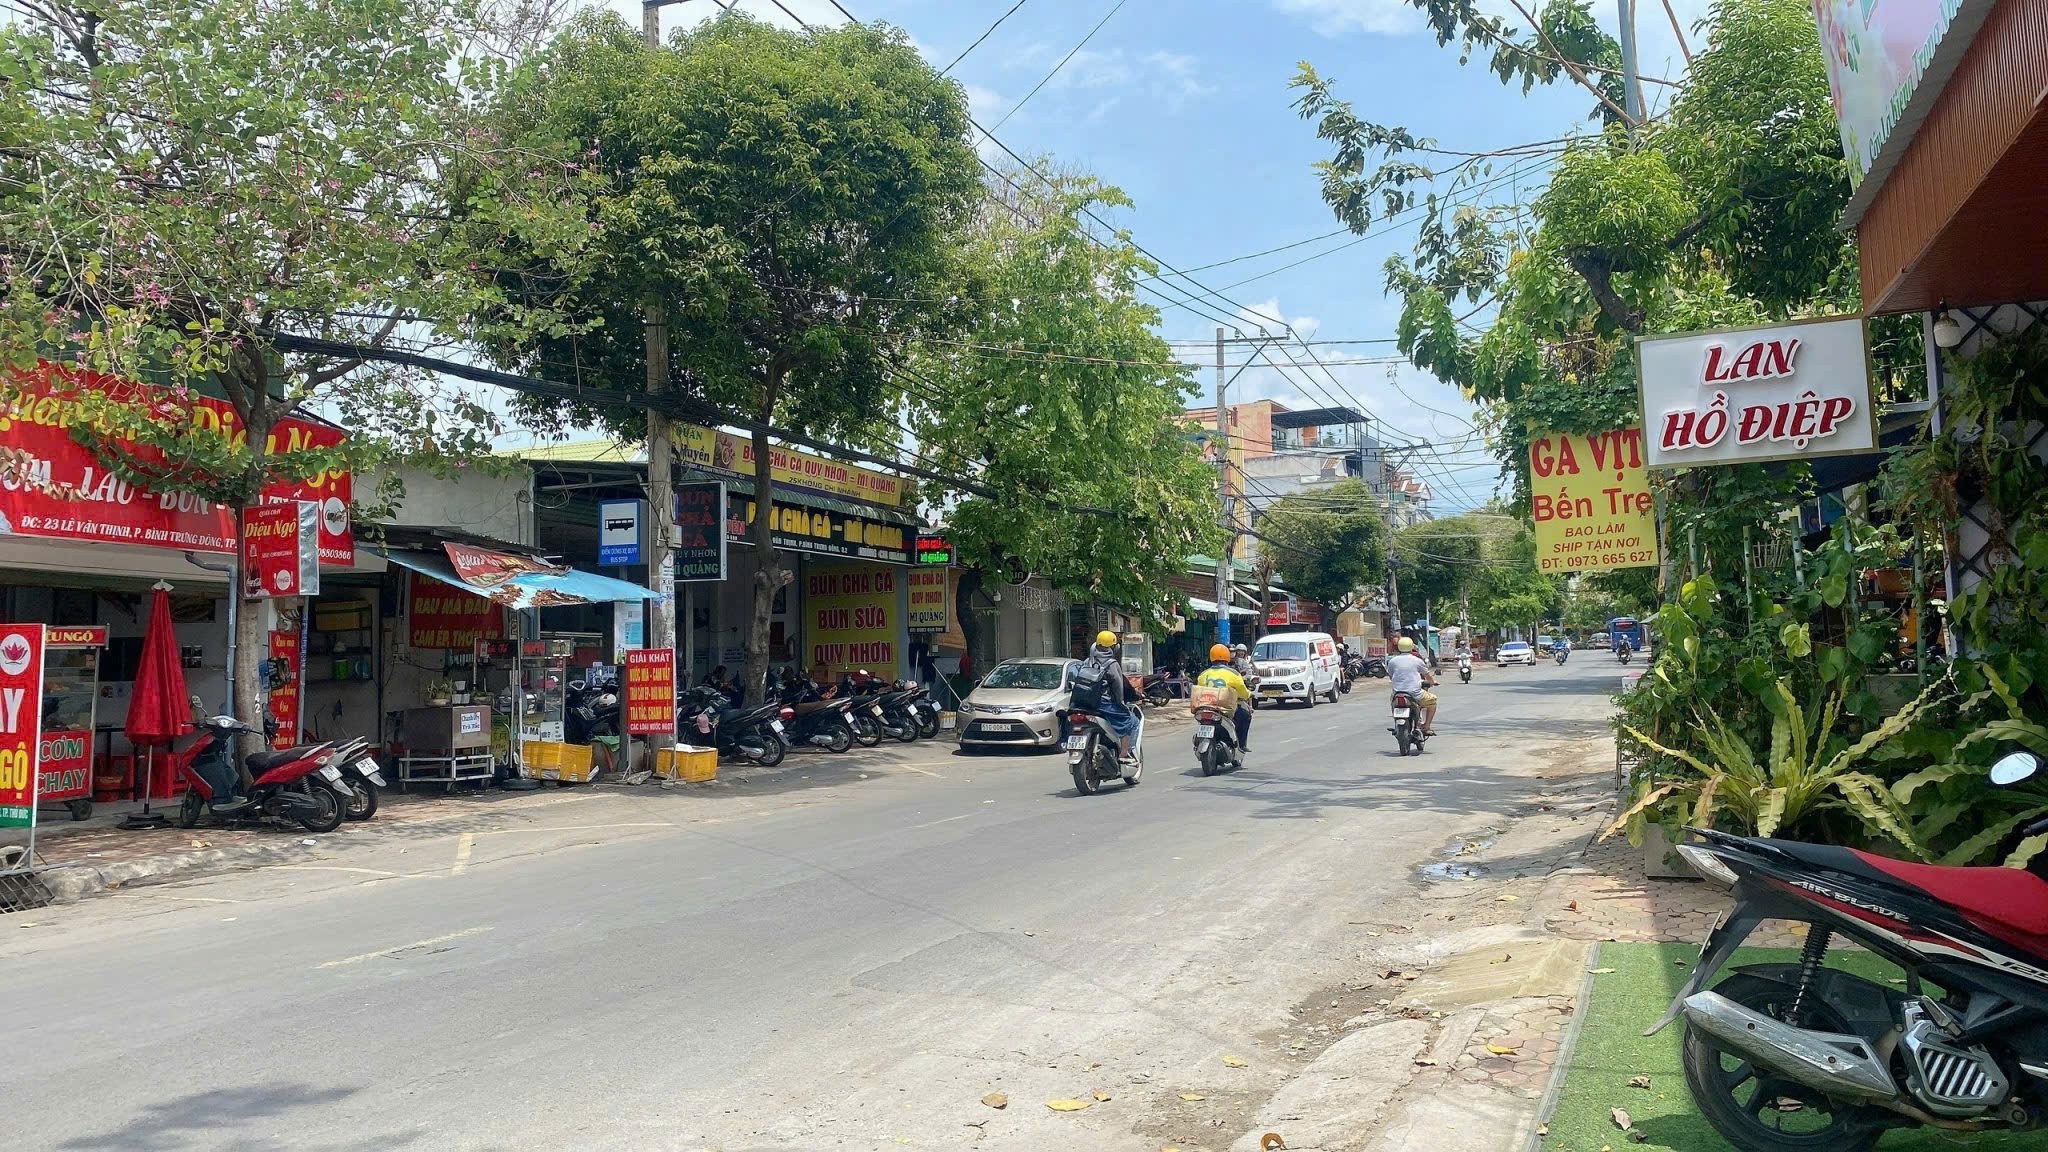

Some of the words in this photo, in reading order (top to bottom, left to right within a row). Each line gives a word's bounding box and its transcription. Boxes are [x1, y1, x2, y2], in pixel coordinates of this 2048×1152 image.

[1705, 339, 1798, 382] LAN
[1662, 393, 1726, 447] HỒ
[1738, 390, 1852, 446] ĐIỆP
[804, 460, 823, 476] QUY
[824, 464, 848, 483] NHƠN
[1533, 486, 1593, 522] Bến
[21, 515, 41, 529] ĐC:
[43, 517, 59, 530] 23
[61, 518, 74, 532] LÊ
[76, 520, 97, 534] VĂN
[145, 527, 168, 540] BÌNH
[245, 522, 271, 541] Diệu
[273, 518, 297, 538] Ngộ
[1565, 525, 1594, 538] BAO
[1553, 542, 1583, 554] SHIP
[1616, 536, 1641, 548] NƠI
[683, 560, 719, 577] QUẢNG
[1542, 558, 1563, 569] ĐT:
[1567, 555, 1599, 567] 0973
[1602, 552, 1626, 565] 665
[1629, 550, 1653, 562] 627
[630, 652, 647, 664] GIẢI
[648, 652, 671, 662] KHÁT
[848, 640, 893, 664] NHƠN
[39, 735, 84, 763] CƠM
[1788, 880, 1832, 897] AIR
[1834, 892, 1910, 923] BLADE
